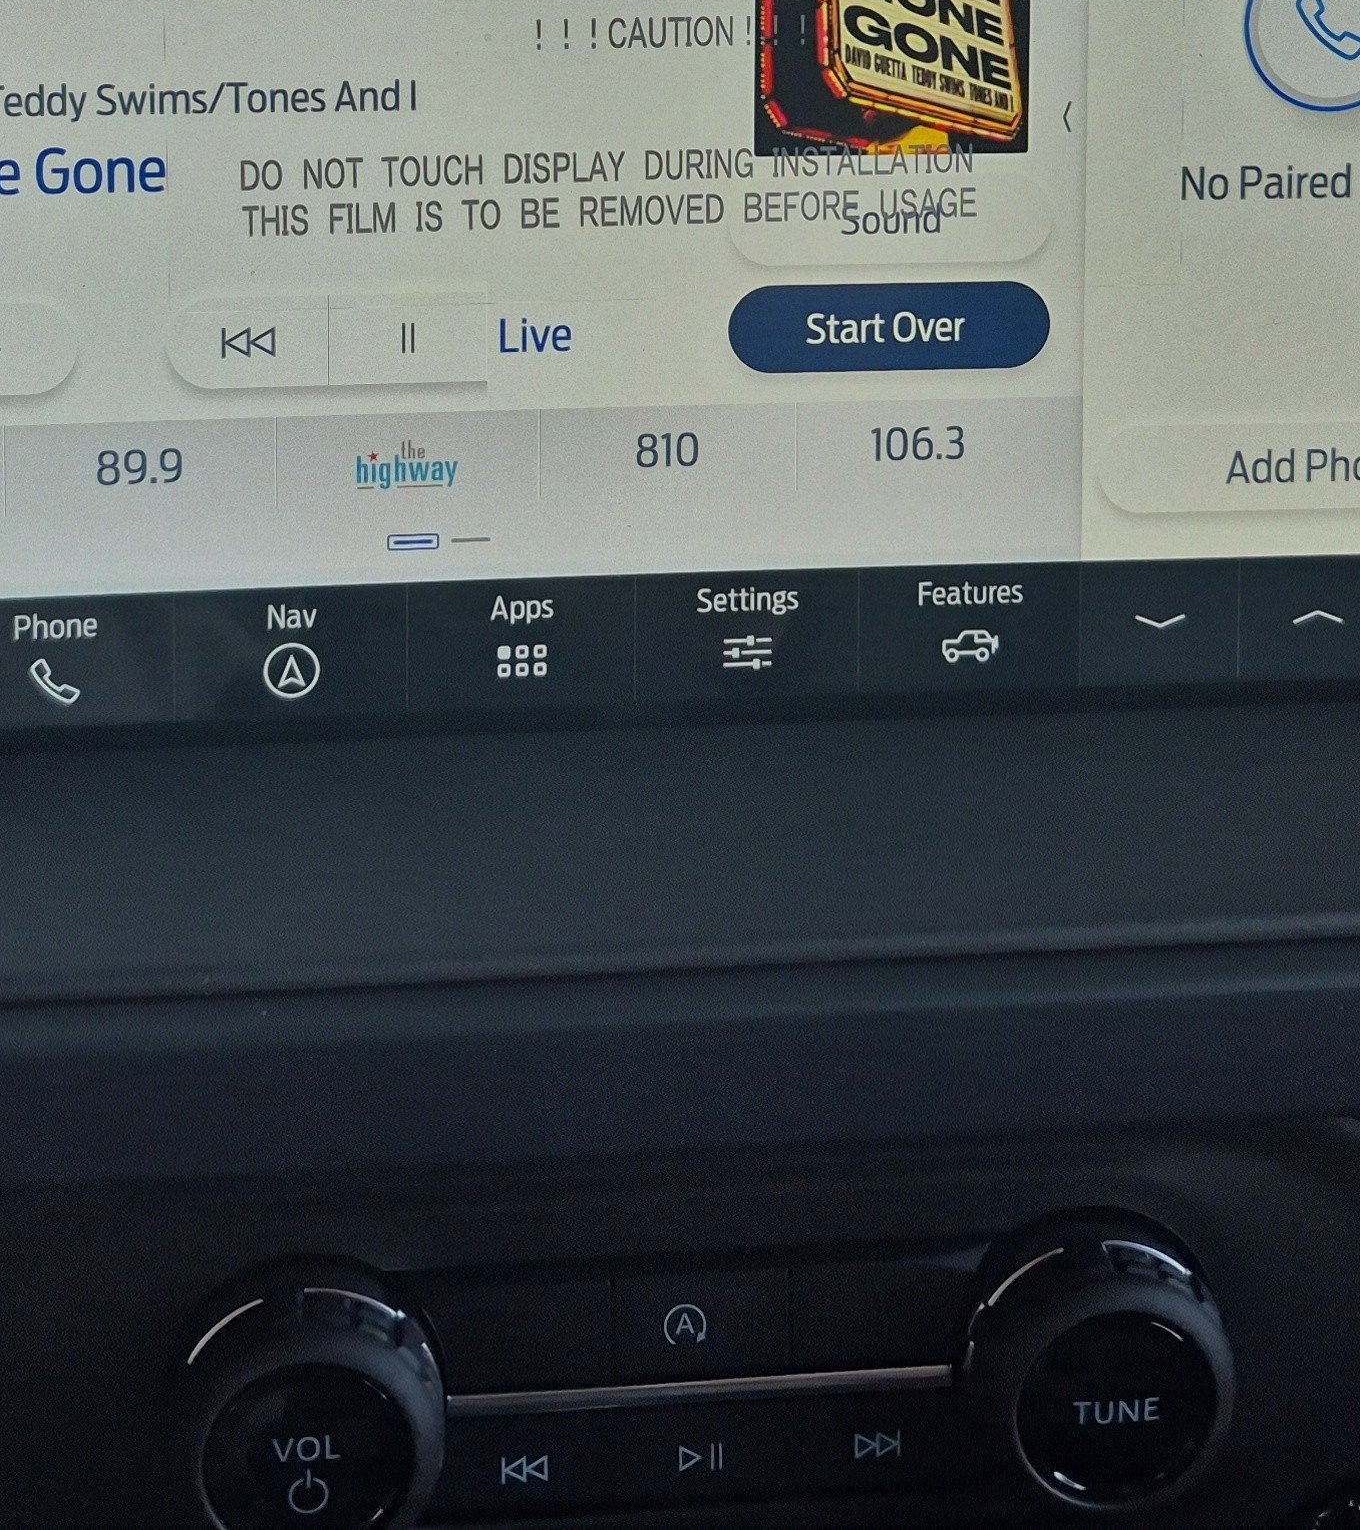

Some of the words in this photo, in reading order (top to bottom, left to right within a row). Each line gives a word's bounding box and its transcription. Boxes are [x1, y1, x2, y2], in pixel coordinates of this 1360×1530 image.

[608, 16, 733, 48] CAUTION
[844, 5, 1011, 90] GONE
[96, 81, 327, 116] Swims/Tones
[334, 78, 400, 113] And
[410, 79, 417, 111] I
[35, 146, 167, 195] Gone
[240, 159, 283, 192] DO
[303, 156, 364, 190] NOT
[380, 154, 484, 188] TOUCH
[503, 150, 626, 185] DISPLAY
[644, 147, 754, 181] DURING
[771, 143, 974, 178] INSTALLATION
[1181, 165, 1229, 201] No
[1239, 162, 1352, 200] Paired
[241, 203, 309, 238] THIS
[329, 201, 396, 235] FILM
[415, 200, 443, 233] IS
[460, 198, 502, 231] TO
[520, 197, 561, 230] BE
[579, 193, 725, 228] REMOVED
[743, 190, 860, 222] BEFORE
[880, 187, 977, 218] USAGE
[840, 202, 941, 235] Sound
[499, 317, 572, 354] Live
[806, 312, 886, 345] Start
[892, 311, 966, 343] Over
[401, 439, 426, 460] the
[636, 431, 699, 469] 810
[870, 425, 965, 462] 106.3
[96, 447, 183, 486] 89.9
[356, 454, 459, 489] highway
[1225, 447, 1296, 485] Add
[490, 595, 555, 625] Apps
[696, 586, 799, 616] Settings
[918, 581, 1024, 607] Features
[13, 613, 98, 641] Phone
[267, 603, 318, 630] Nav
[1072, 1396, 1160, 1425] TUNE
[272, 1434, 341, 1463] VOL
